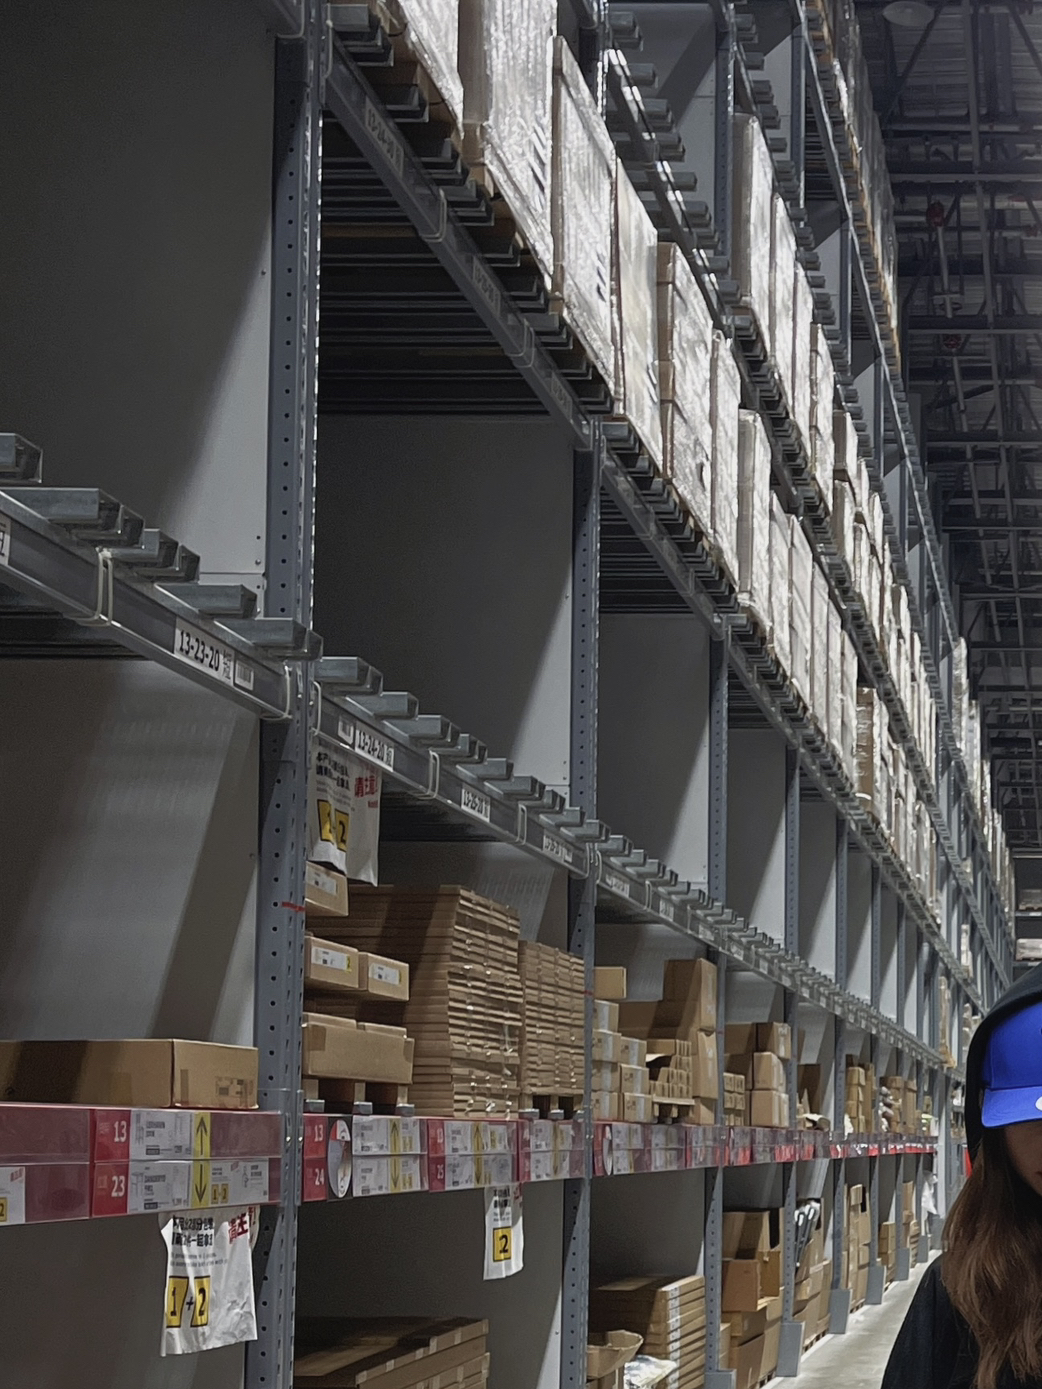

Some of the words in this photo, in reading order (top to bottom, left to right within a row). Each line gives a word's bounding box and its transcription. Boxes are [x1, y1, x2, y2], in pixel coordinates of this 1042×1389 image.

[179, 629, 221, 672] 13-23-20
[113, 1120, 128, 1143] 13
[314, 1124, 325, 1142] 13
[111, 1175, 126, 1198] 23
[315, 1167, 325, 1186] 24
[499, 1234, 509, 1254] 2
[170, 1286, 177, 1317] 1
[198, 1287, 207, 1317] 2
